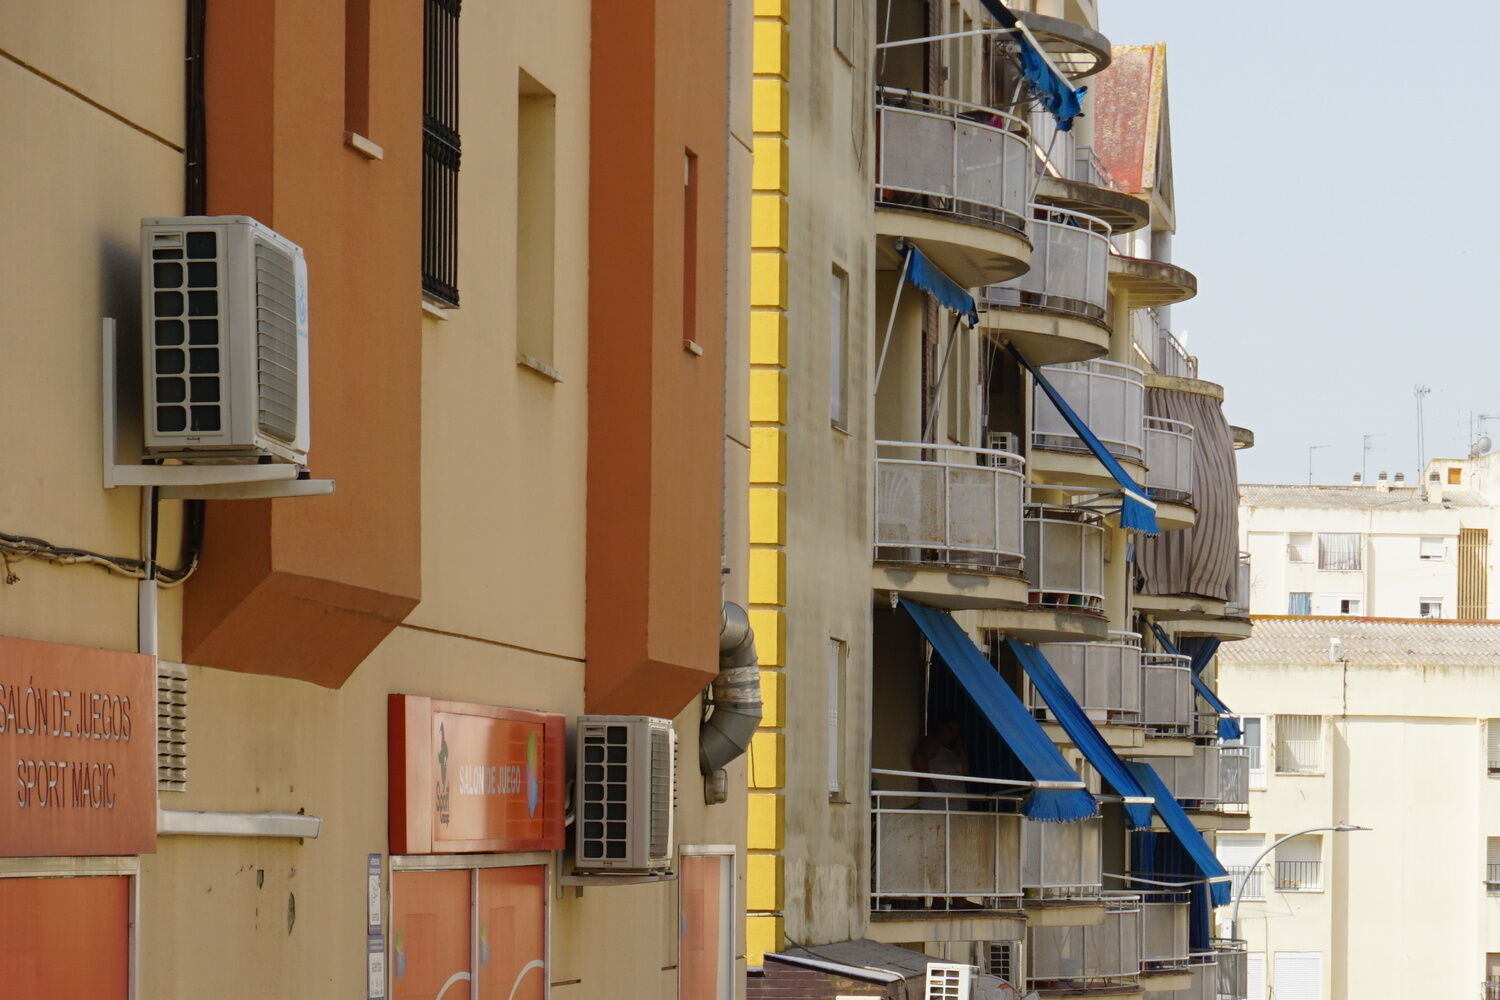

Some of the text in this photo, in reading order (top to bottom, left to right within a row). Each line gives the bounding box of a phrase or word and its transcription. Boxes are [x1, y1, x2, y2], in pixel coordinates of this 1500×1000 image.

[0, 675, 132, 742] SALÓN DE JUEGOS
[17, 759, 115, 809] SPORT MAGIC
[486, 766, 496, 795] DE
